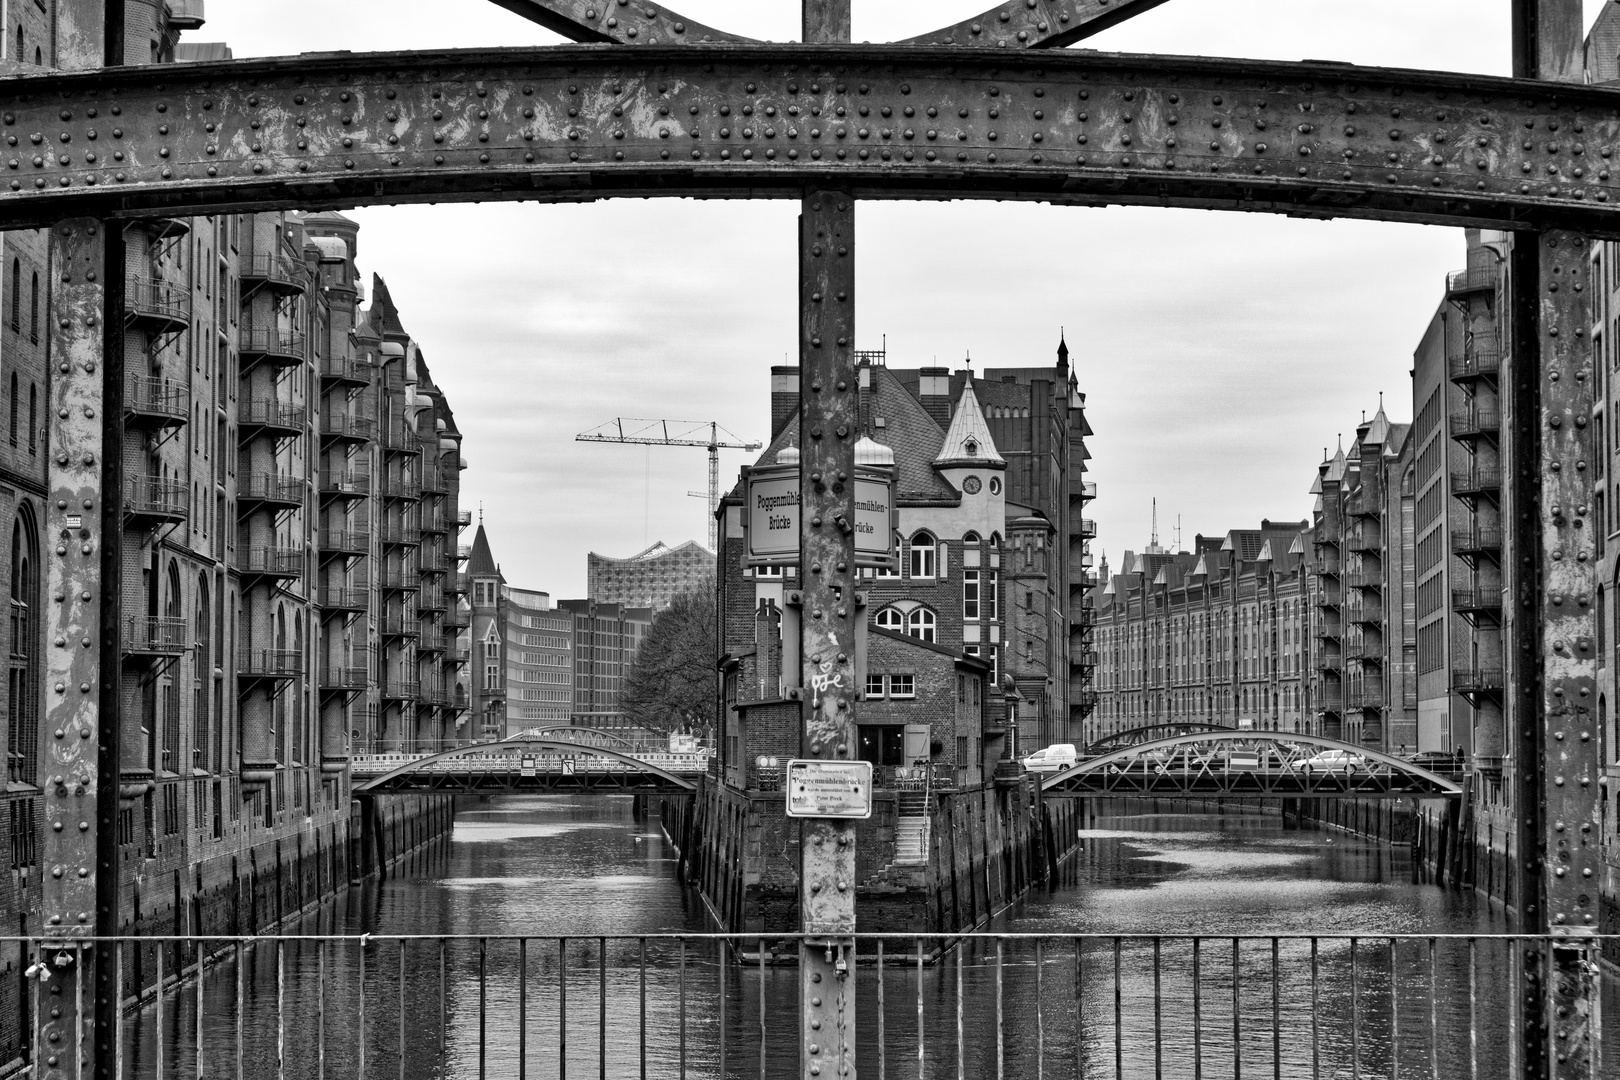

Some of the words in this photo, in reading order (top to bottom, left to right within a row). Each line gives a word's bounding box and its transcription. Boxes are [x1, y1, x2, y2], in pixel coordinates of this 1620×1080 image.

[757, 491, 800, 511] Poggenmühle
[769, 515, 791, 530] Brücke
[855, 522, 874, 534] rücke
